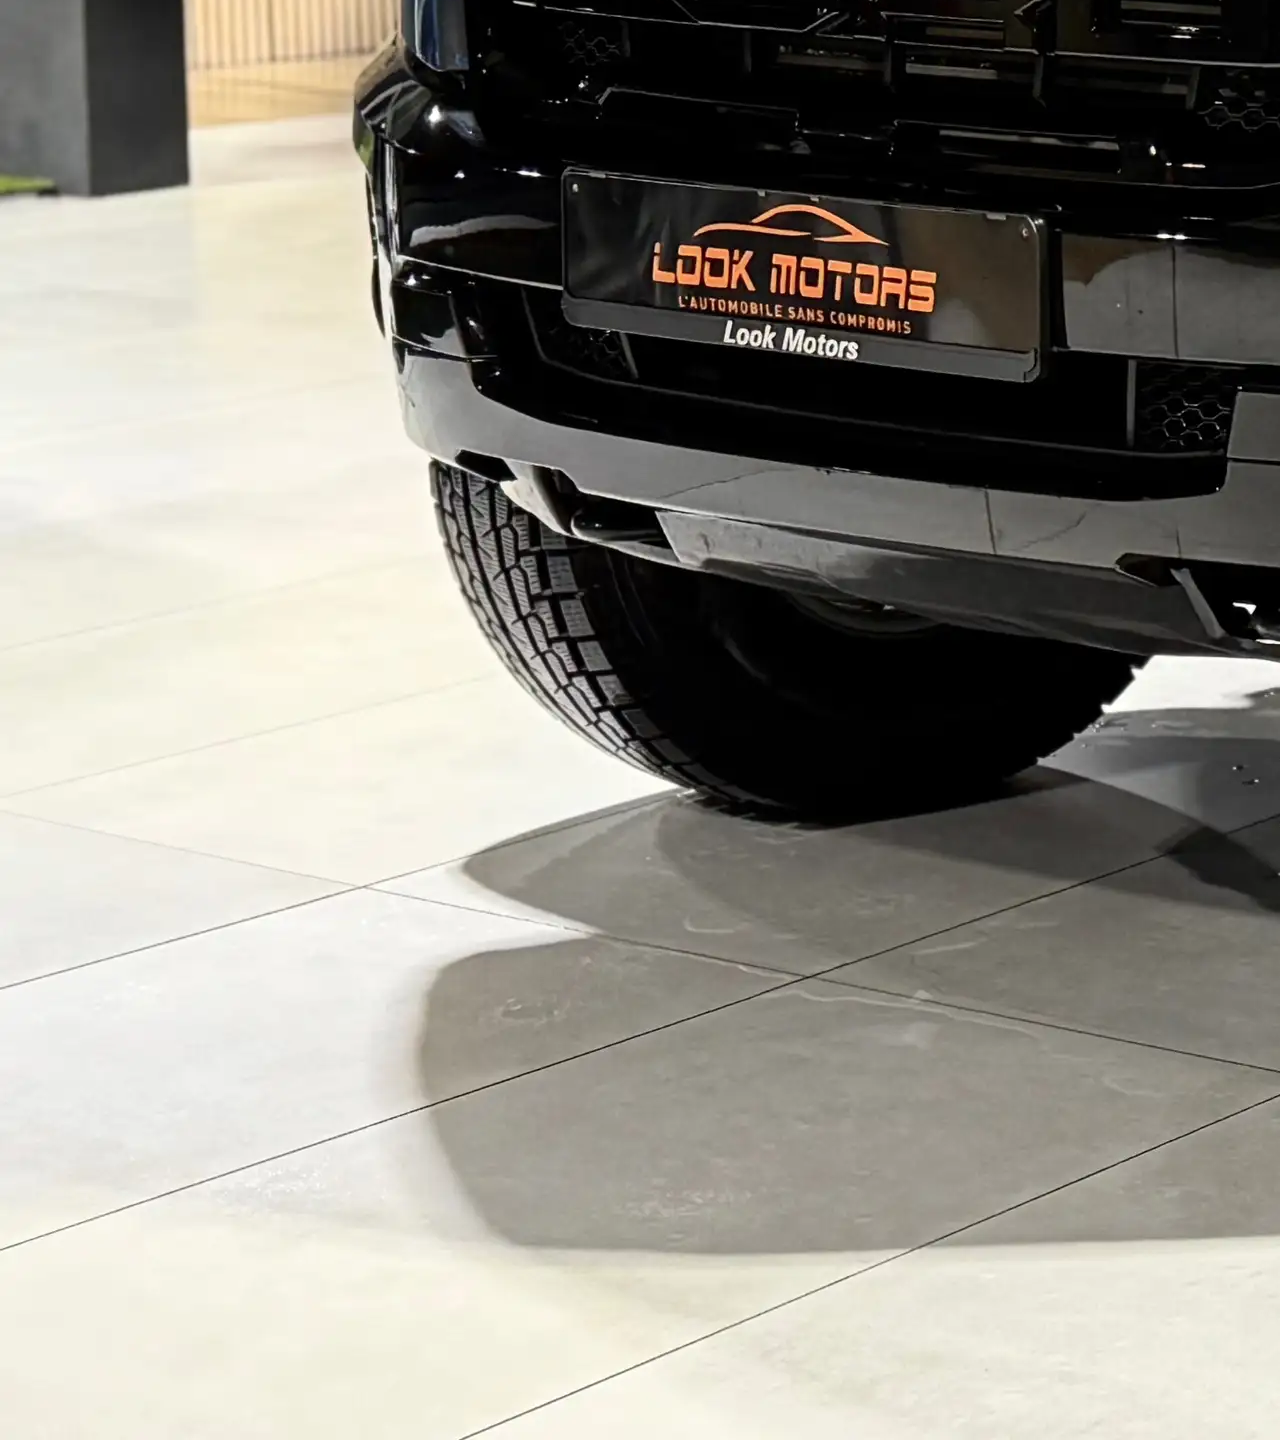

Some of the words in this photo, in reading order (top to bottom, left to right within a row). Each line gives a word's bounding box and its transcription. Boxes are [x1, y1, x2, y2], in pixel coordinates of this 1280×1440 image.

[652, 241, 756, 292] LOOK
[770, 253, 937, 313] MOTORS
[678, 295, 783, 318] L'AUTOMOBILE
[788, 306, 825, 322] SANS
[830, 311, 912, 334] COMPROMIS
[723, 319, 777, 349] Look
[781, 327, 859, 360] Motors
